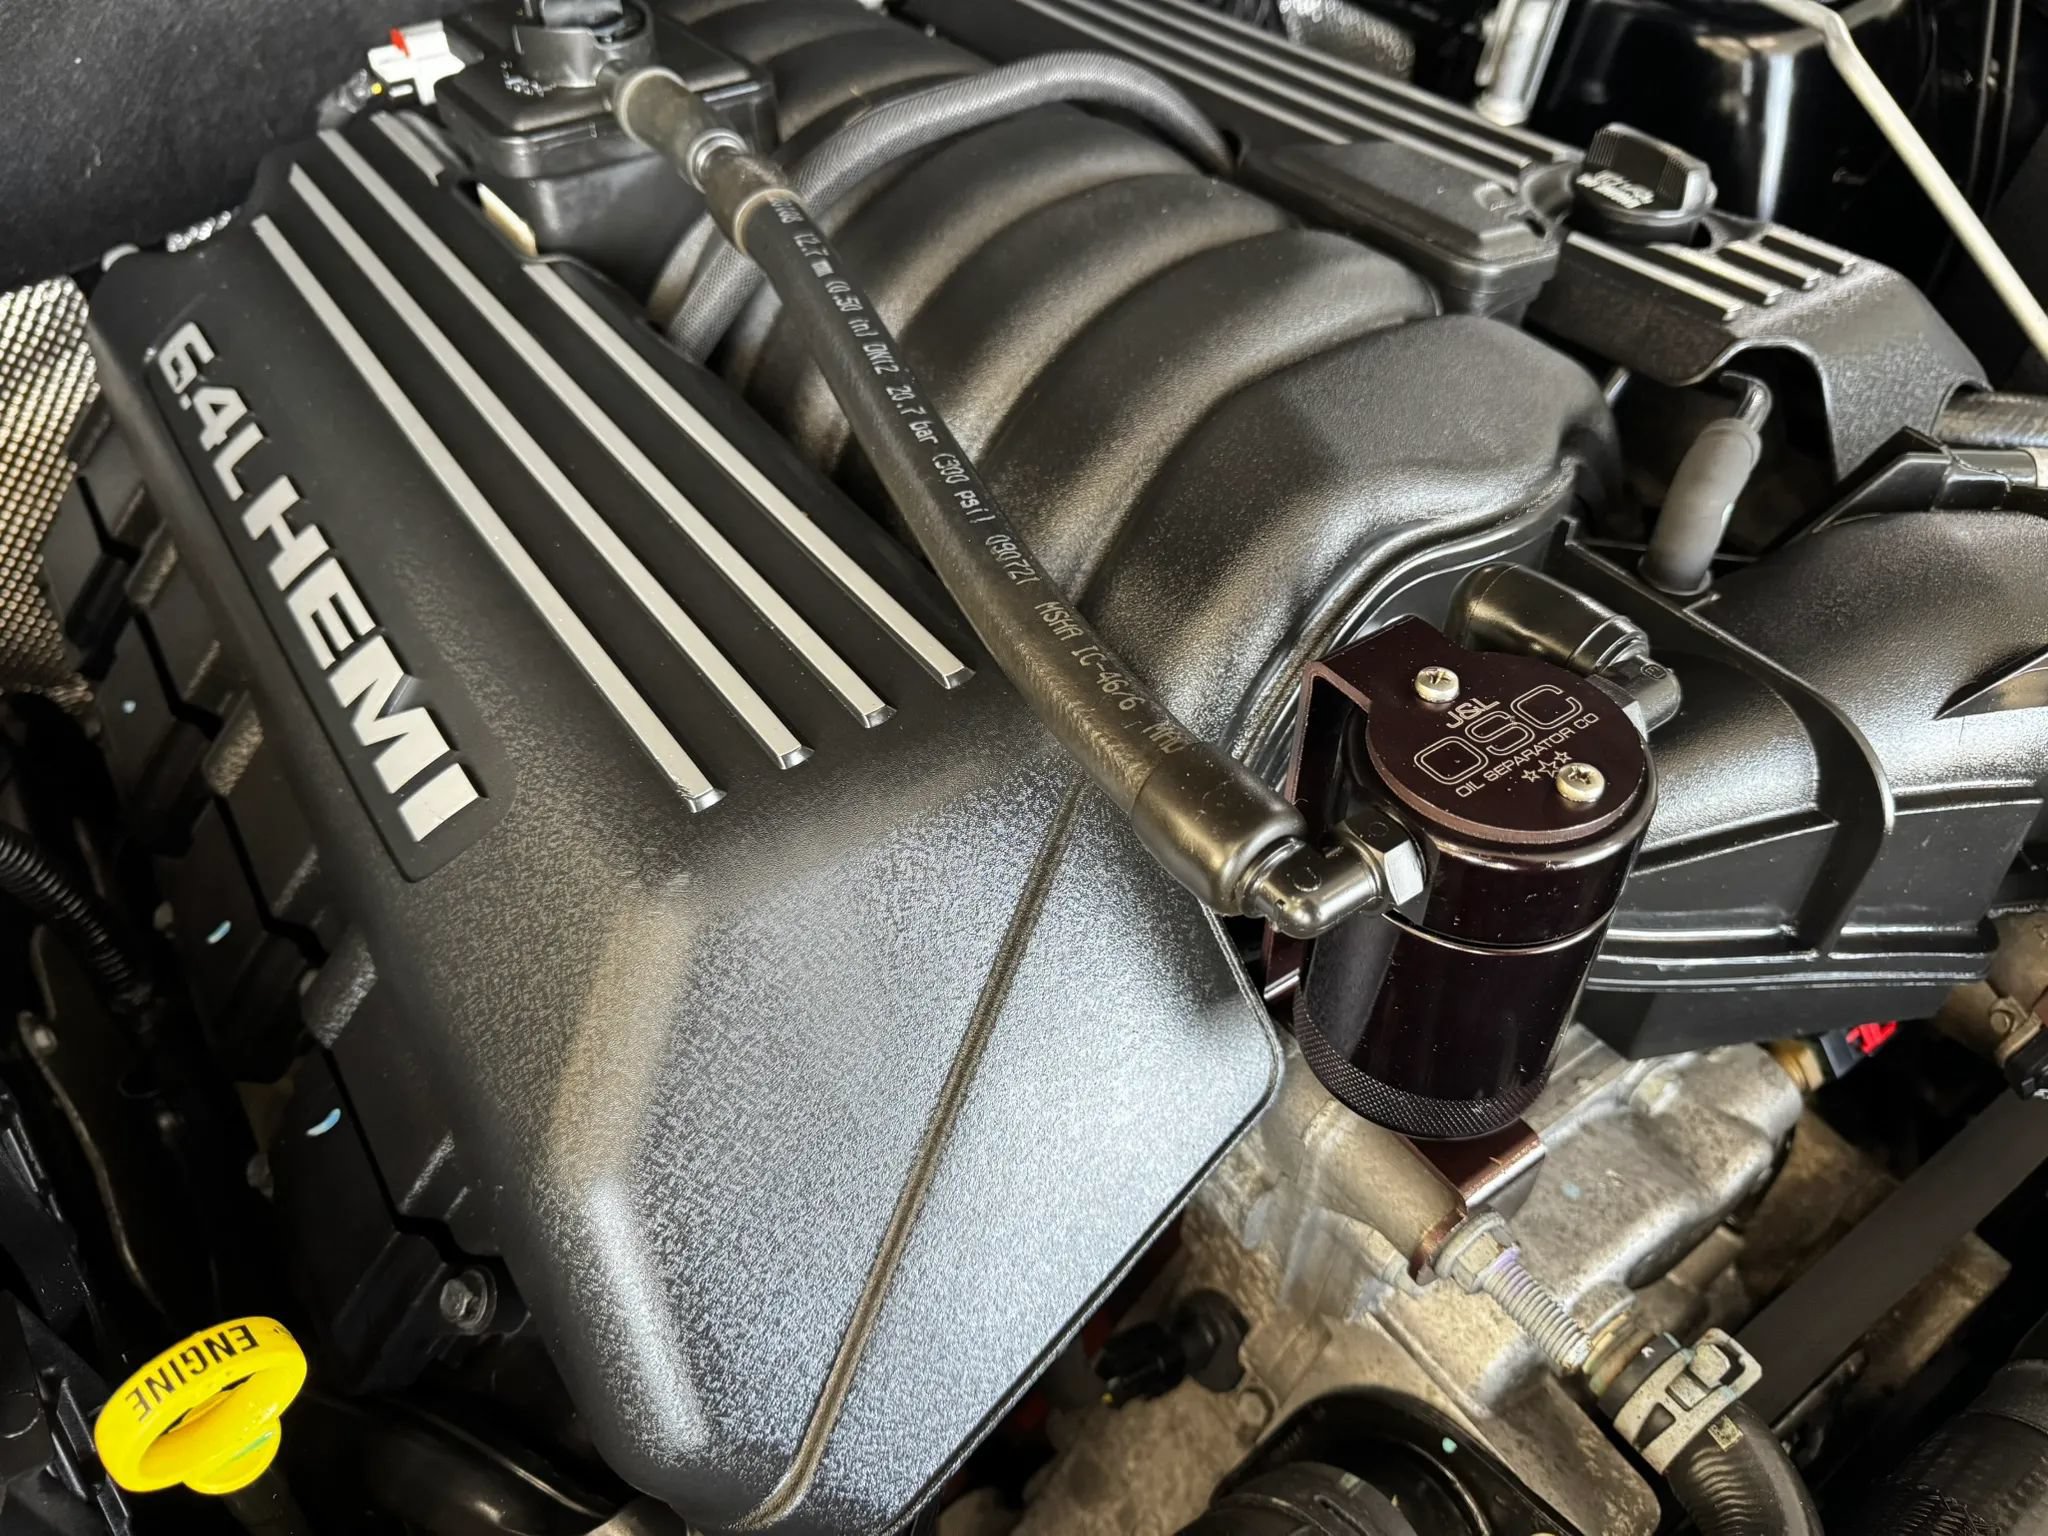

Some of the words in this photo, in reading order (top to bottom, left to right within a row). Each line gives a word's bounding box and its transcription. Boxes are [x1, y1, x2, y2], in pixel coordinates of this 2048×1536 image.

[825, 281, 863, 312] (0.50
[848, 319, 879, 337] in)
[862, 343, 900, 375] DN12
[886, 385, 927, 415] 20.7
[908, 420, 939, 444] bar
[931, 453, 970, 484] (300
[953, 490, 996, 524] psi)
[985, 534, 1042, 586] 090721
[157, 321, 264, 501] 6.4L
[241, 474, 480, 842] HEMI
[1034, 601, 1084, 641] MSHA
[1446, 698, 1500, 729] J&L
[1414, 684, 1583, 785] OSC
[1455, 780, 1486, 798] OIL
[1483, 727, 1576, 782] SEPARATOR
[1573, 712, 1600, 730] CO
[125, 1324, 260, 1422] ENGINE
